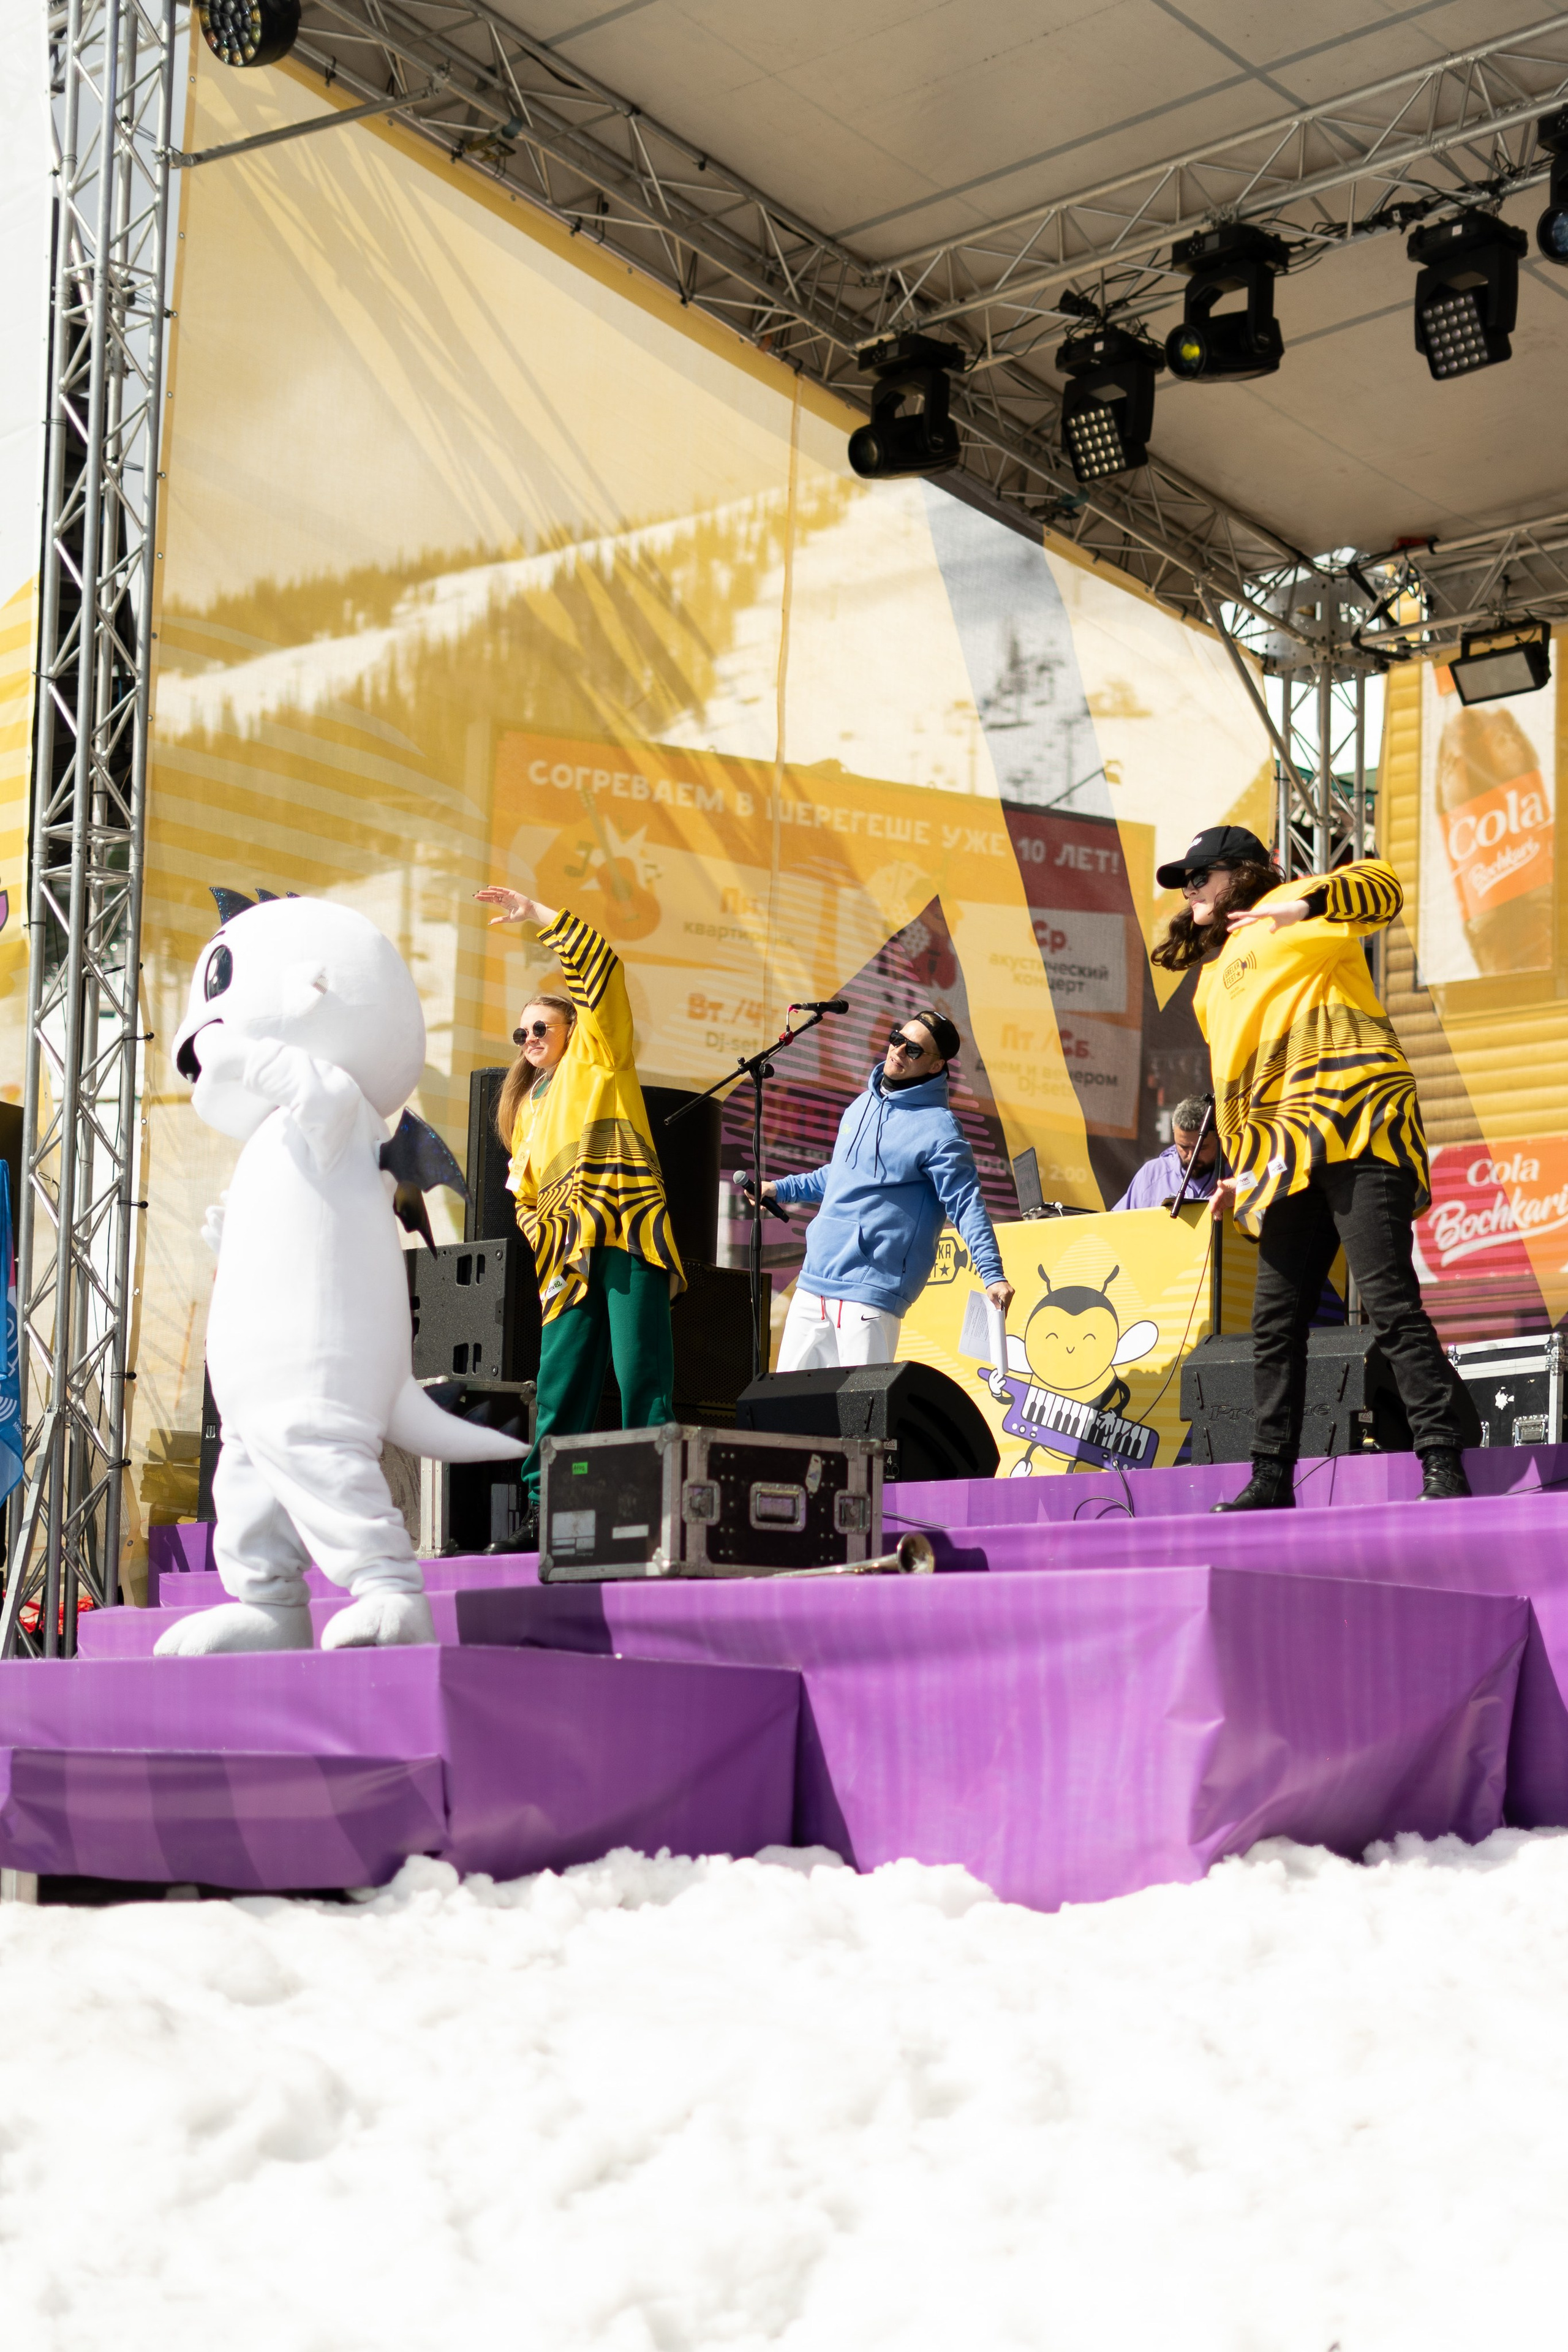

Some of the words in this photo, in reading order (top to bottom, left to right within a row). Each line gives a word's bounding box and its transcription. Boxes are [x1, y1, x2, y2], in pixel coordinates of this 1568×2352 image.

[527, 759, 725, 813] СОГРЕВАЕМ
[735, 790, 755, 818] В
[765, 797, 931, 845] ШЕРЕГЕШЕ
[941, 824, 1006, 857] УЖЕ
[1017, 837, 1046, 864] 10
[1055, 843, 1120, 874] ЛЕТ!
[1448, 789, 1544, 861] Cola
[988, 953, 1109, 982] акустический
[1226, 973, 1237, 986] FEST
[1013, 973, 1085, 995] концерт
[1466, 1153, 1540, 1188] Cola
[1427, 1183, 1568, 1252] Bochkari
[1362, 1428, 1368, 1440] 2
[886, 1455, 892, 1465] 4
